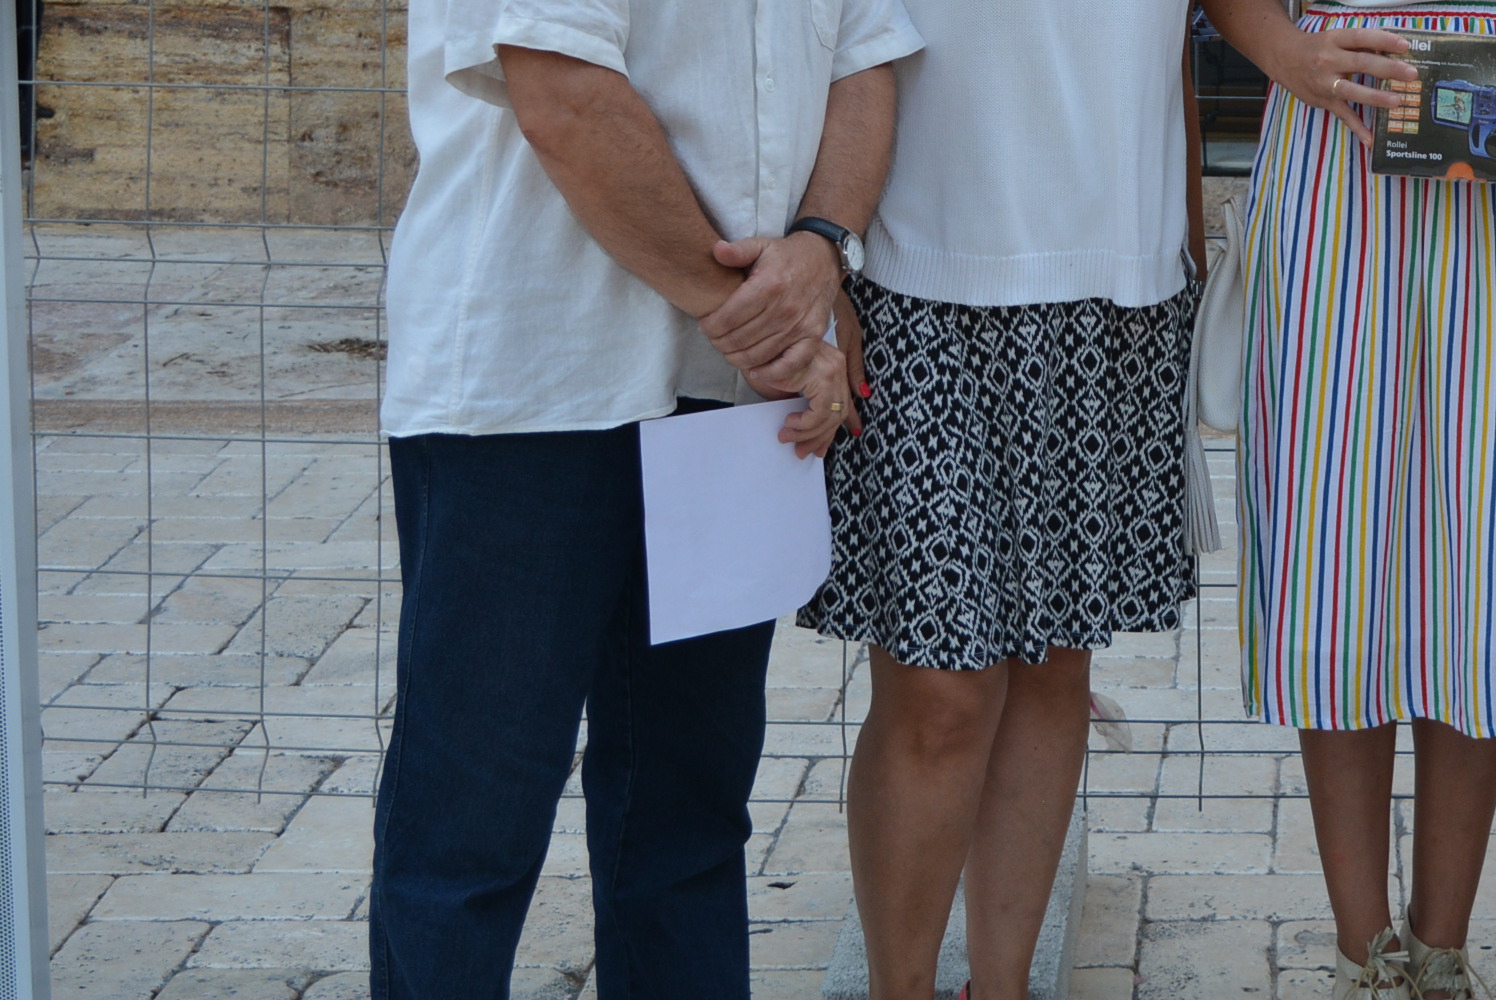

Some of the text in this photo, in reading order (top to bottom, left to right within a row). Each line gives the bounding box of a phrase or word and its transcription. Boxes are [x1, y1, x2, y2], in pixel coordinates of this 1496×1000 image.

[1386, 140, 1408, 149] Rollei
[1386, 150, 1443, 161] Sportsline 100
